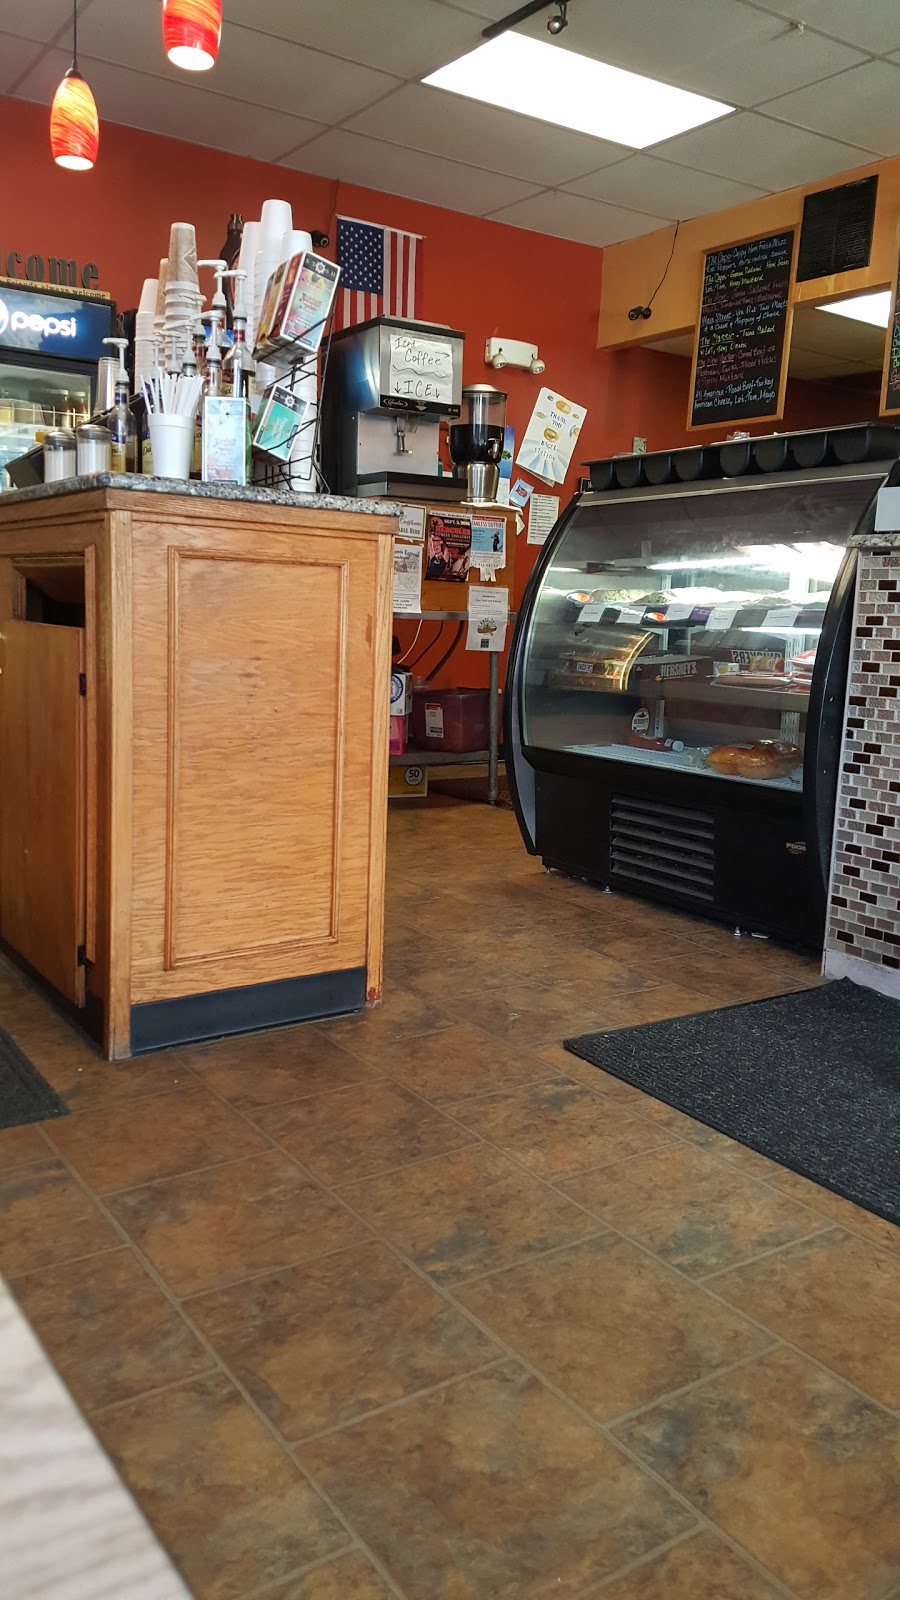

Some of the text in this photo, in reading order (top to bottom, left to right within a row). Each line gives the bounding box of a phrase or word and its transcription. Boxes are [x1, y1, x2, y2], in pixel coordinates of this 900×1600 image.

[72, 288, 106, 299] welcome
[11, 311, 77, 338] pepsi
[394, 336, 416, 350] Iced
[404, 348, 442, 366] Coffee
[403, 380, 433, 398] ICE
[550, 411, 567, 425] THANK
[552, 419, 563, 429] YOU
[661, 661, 697, 677] HERSHEY'S
[408, 769, 420, 778] 50
